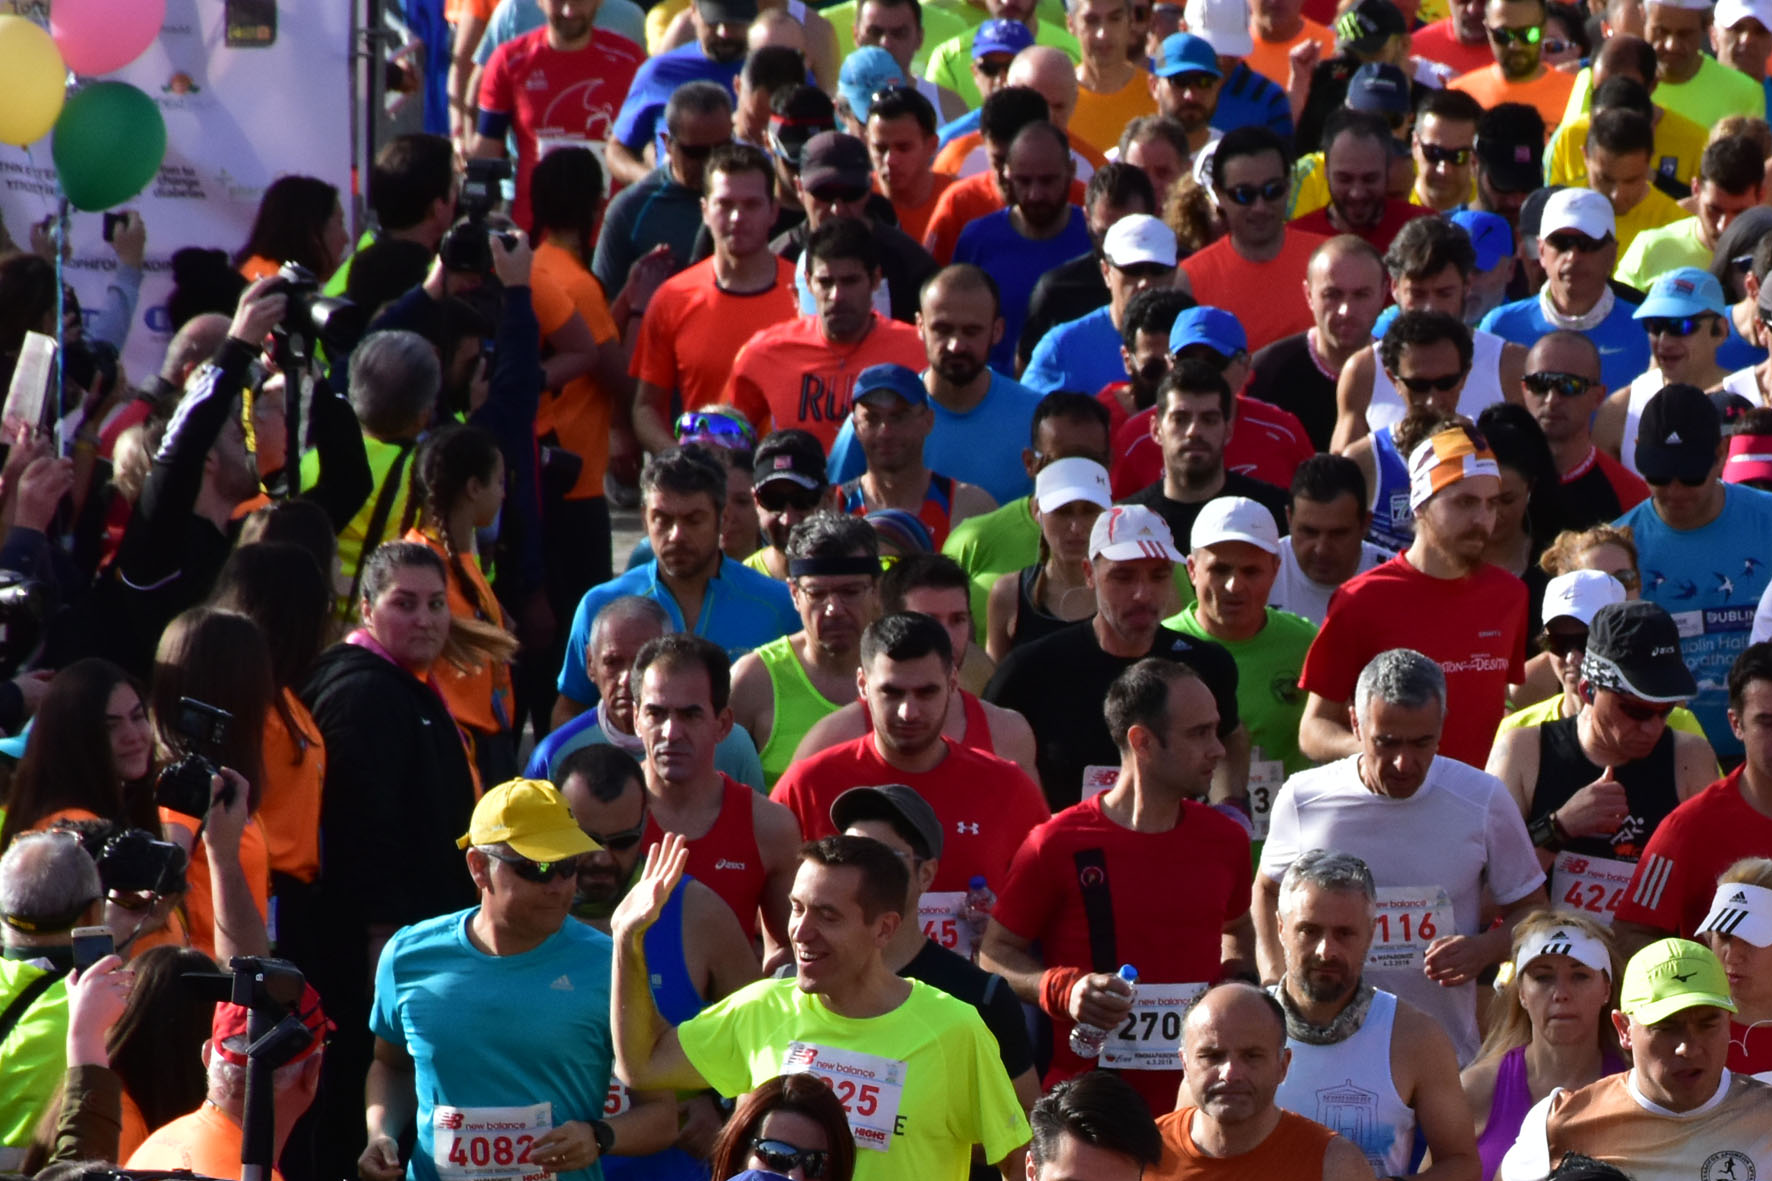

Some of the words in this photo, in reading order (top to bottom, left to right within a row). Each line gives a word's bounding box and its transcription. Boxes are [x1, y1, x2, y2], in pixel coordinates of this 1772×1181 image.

[816, 1061, 836, 1070] new
[837, 1063, 876, 1078] balance
[466, 1122, 486, 1131] new
[487, 1121, 526, 1130] balance
[448, 1134, 537, 1168] 4082
